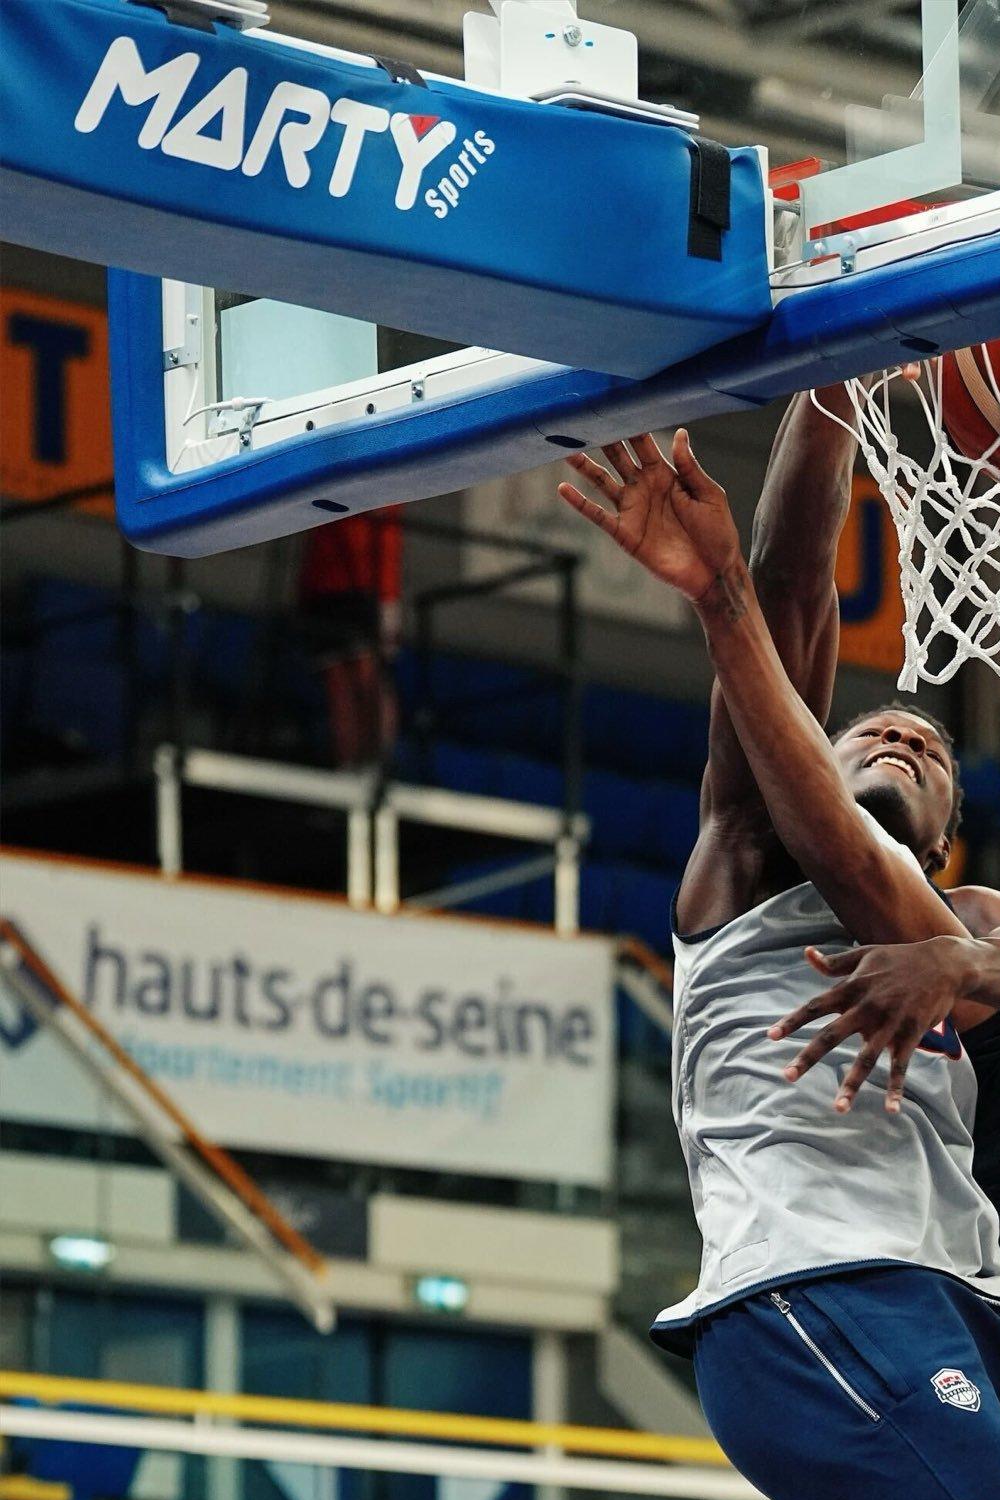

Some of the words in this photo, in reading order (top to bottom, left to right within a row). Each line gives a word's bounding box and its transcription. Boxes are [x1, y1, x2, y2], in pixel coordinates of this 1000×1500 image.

[75, 36, 457, 210] MARTY
[425, 130, 495, 219] Sports
[8, 313, 91, 466] T
